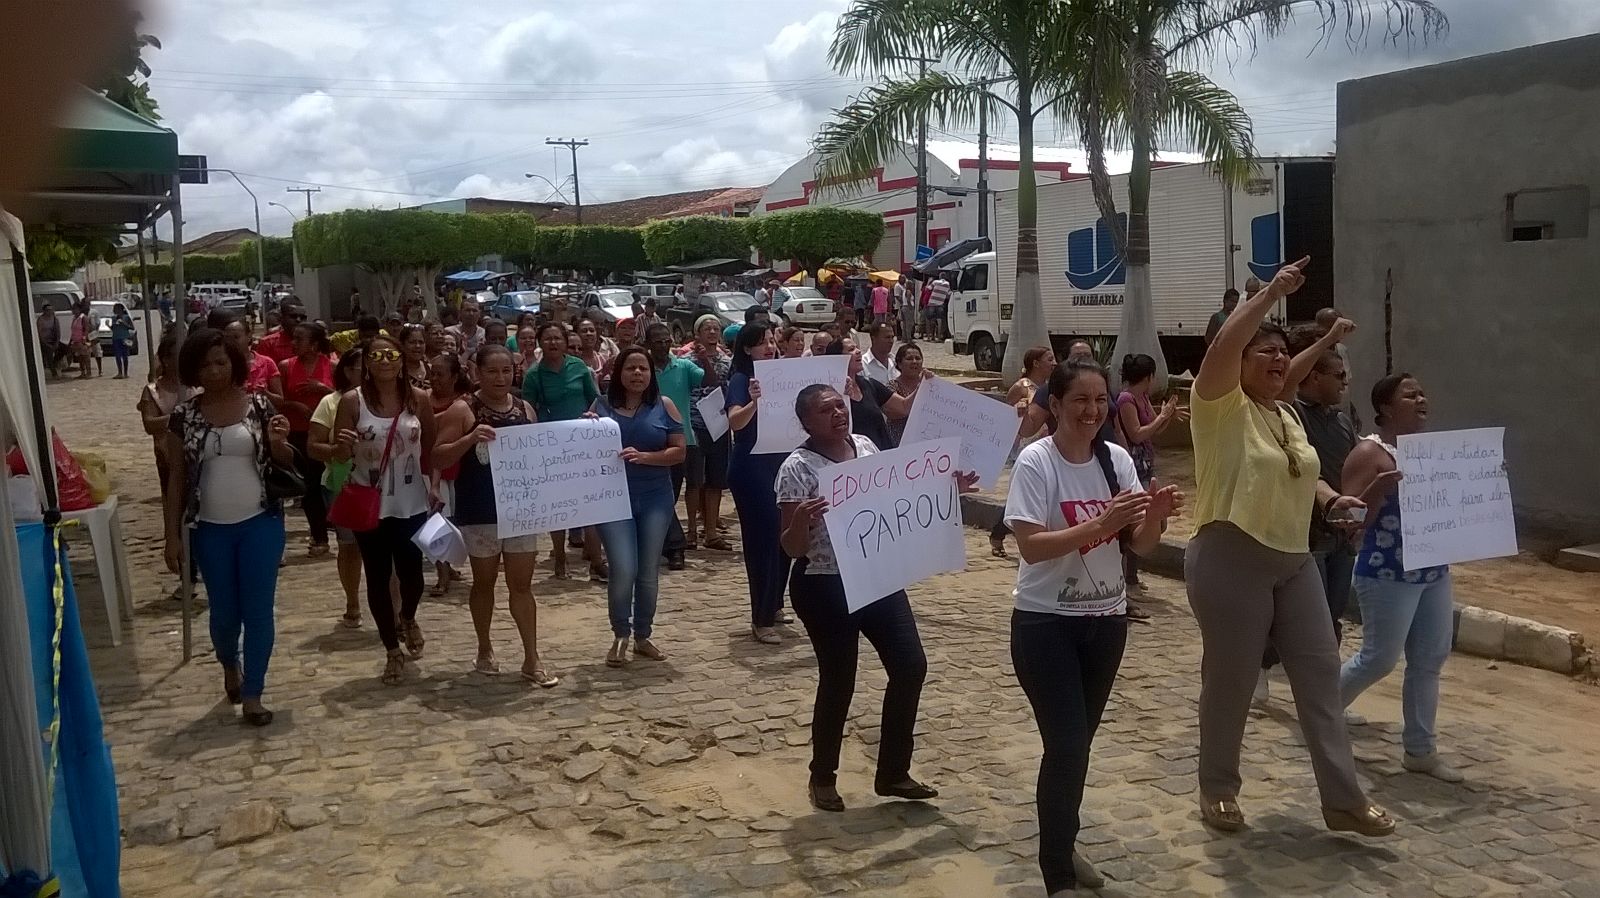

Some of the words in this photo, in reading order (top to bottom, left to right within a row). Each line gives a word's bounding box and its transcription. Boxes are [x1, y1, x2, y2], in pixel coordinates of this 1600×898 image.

[500, 431, 559, 451] FUNDEB
[832, 447, 951, 508] EDUCAÇÃO
[499, 488, 539, 507] CAÇÃO
[506, 503, 537, 522] CADÊ
[541, 504, 547, 514] O
[551, 499, 578, 511] NOSSO
[583, 488, 623, 504] SALÁRIO
[1401, 488, 1452, 513] ENSINAR
[1460, 490, 1484, 512] para
[846, 482, 959, 559] PAROU!
